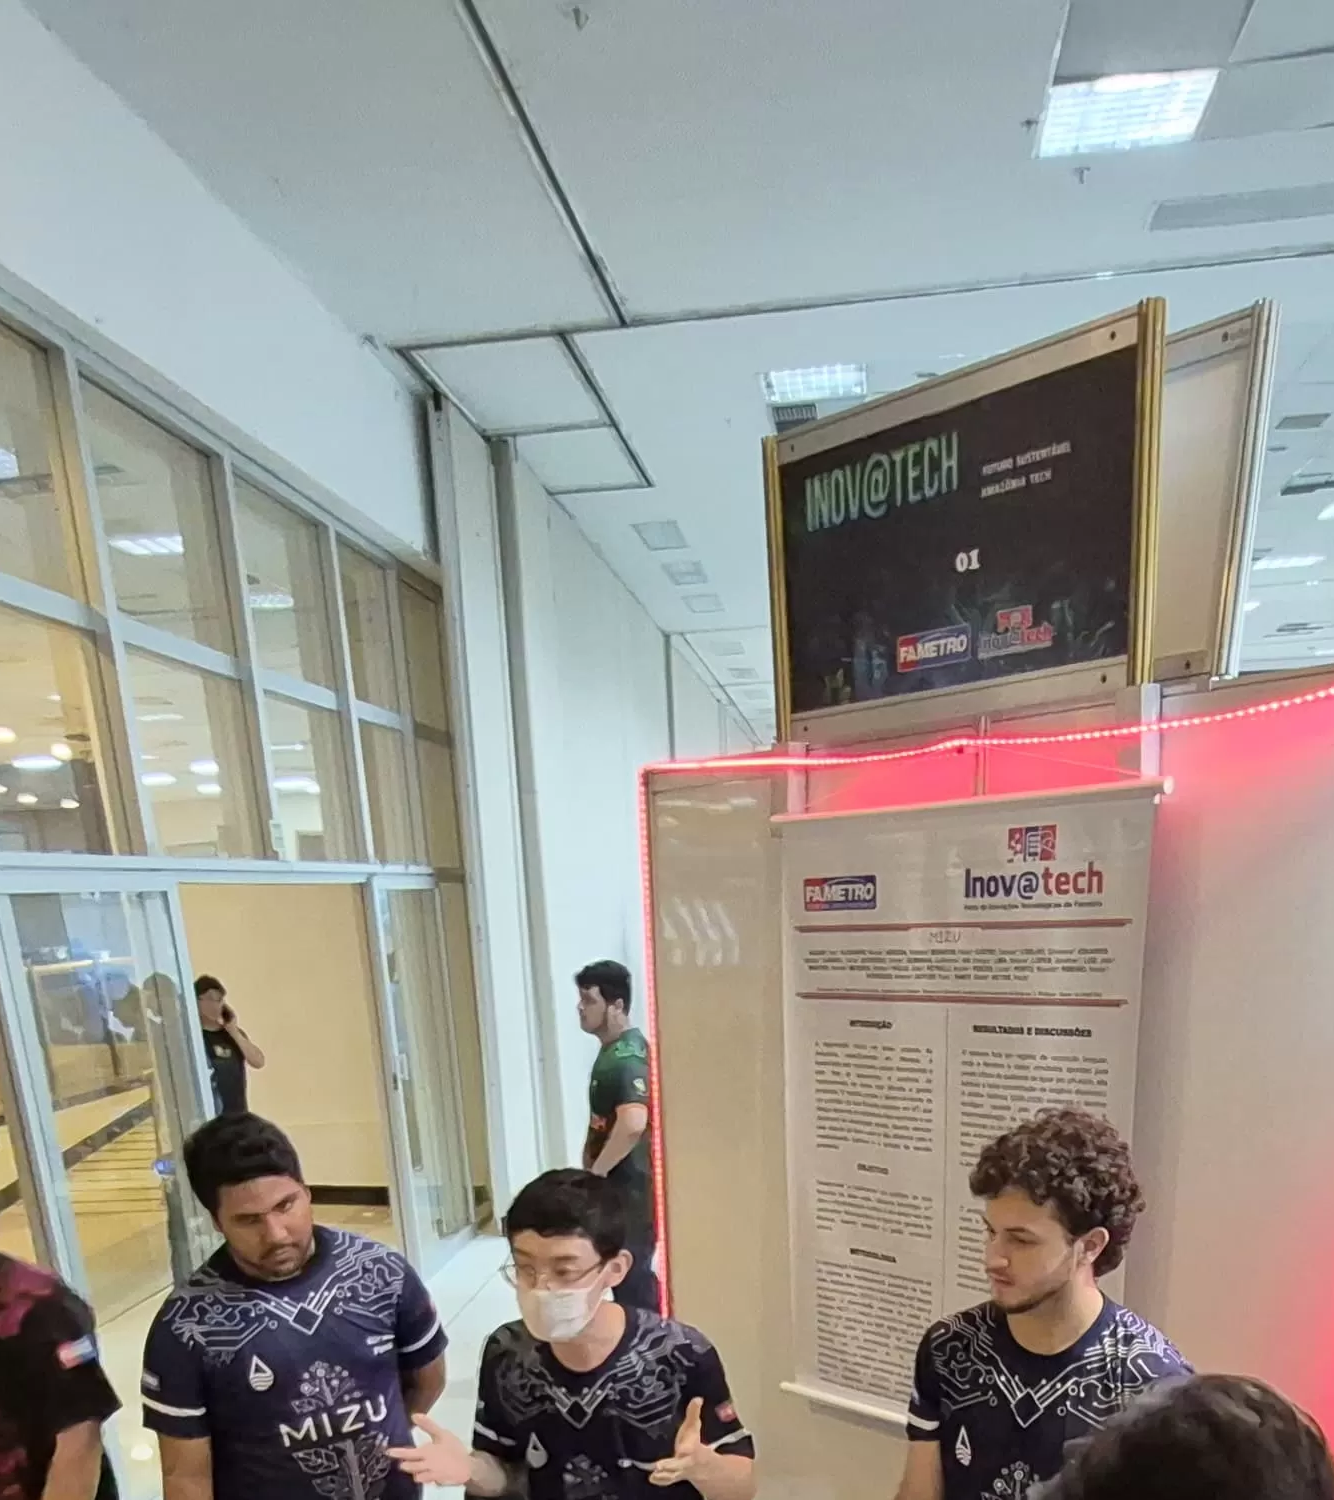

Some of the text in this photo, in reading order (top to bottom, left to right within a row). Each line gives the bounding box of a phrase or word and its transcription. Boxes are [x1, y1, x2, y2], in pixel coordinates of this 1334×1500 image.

[805, 431, 959, 532] INOV@TECH
[955, 549, 980, 572] 01
[899, 635, 967, 663] FAMETRO
[806, 882, 875, 902] FAMETRO
[964, 860, 1103, 900] Inov@tech
[279, 1394, 388, 1447] MIZU
